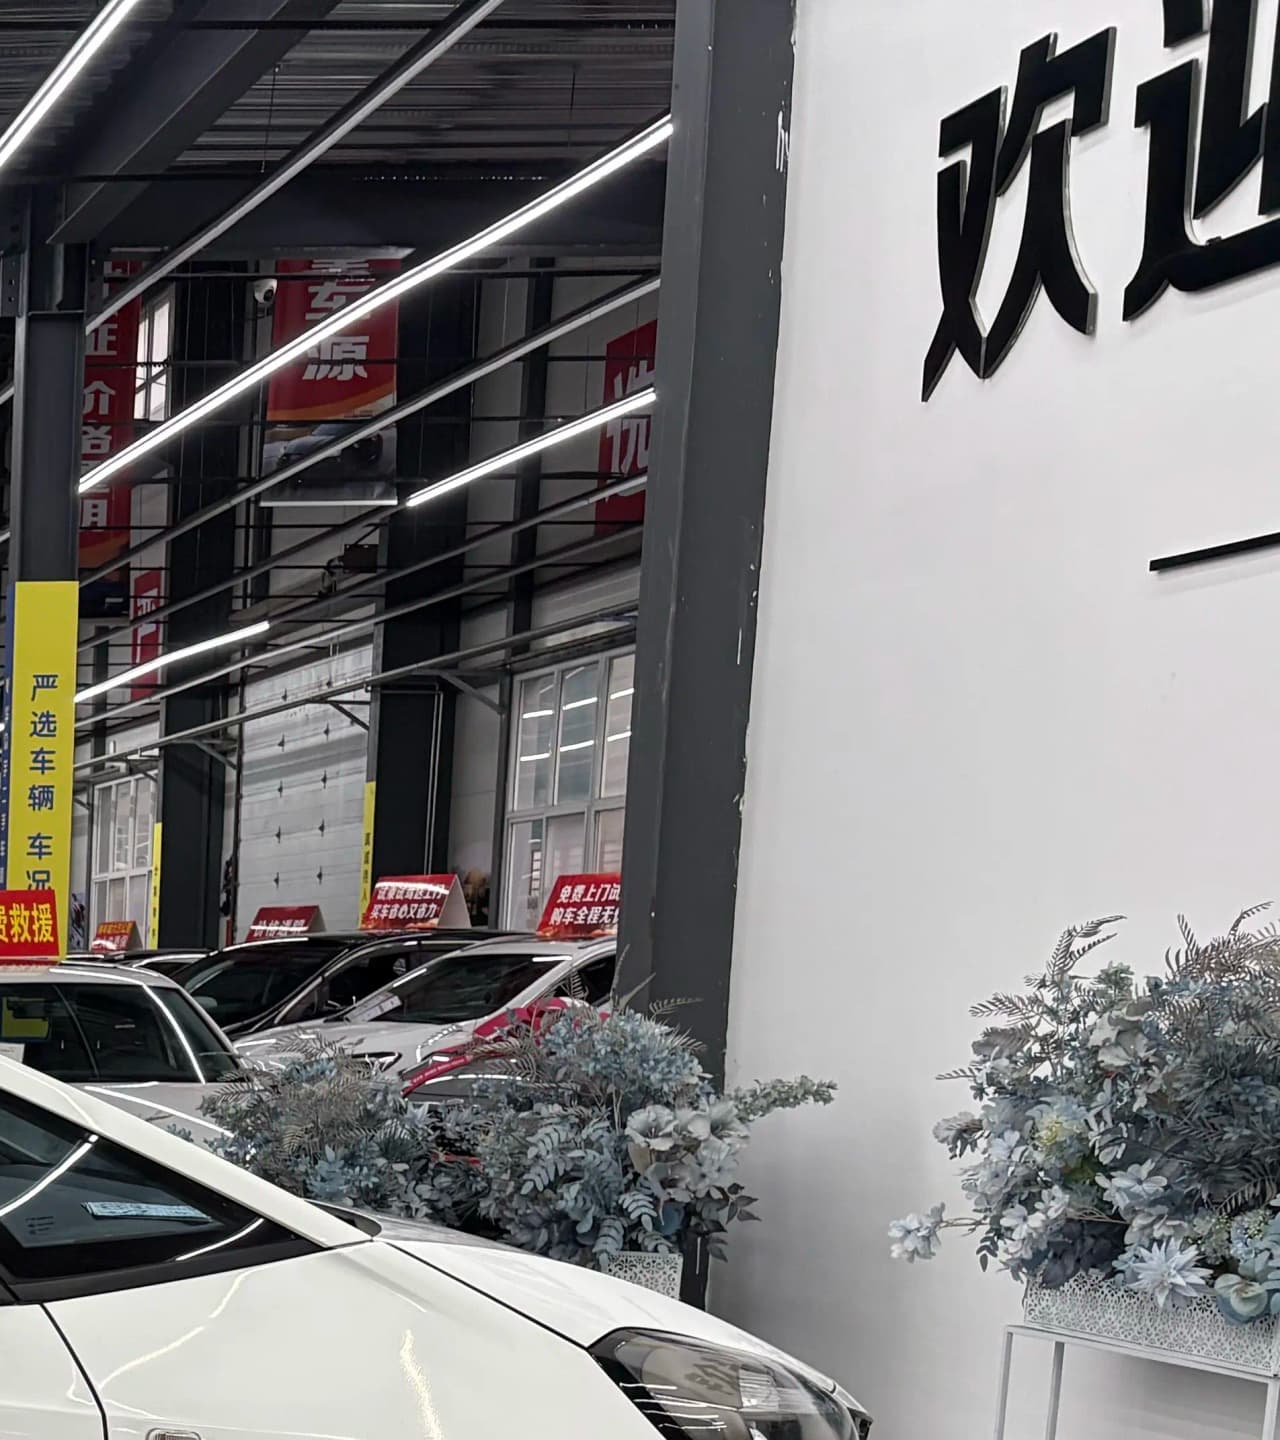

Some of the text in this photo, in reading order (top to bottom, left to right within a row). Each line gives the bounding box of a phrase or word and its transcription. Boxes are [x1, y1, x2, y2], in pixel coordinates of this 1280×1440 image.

[921, 0, 1280, 402] 欢迎
[28, 674, 59, 812] 严选车辆
